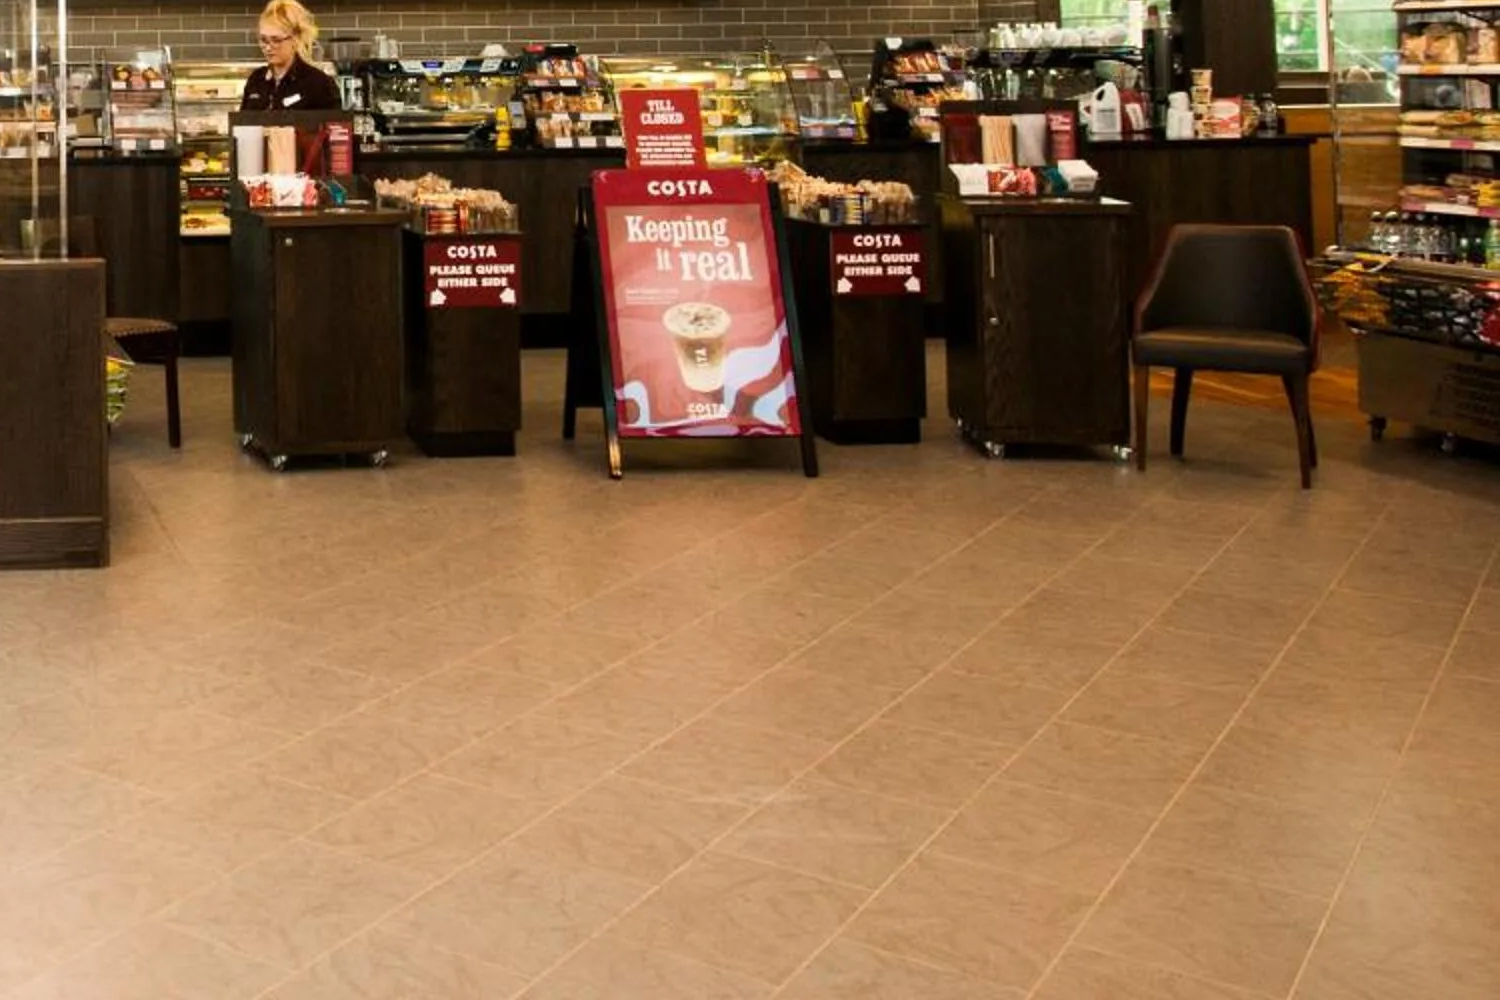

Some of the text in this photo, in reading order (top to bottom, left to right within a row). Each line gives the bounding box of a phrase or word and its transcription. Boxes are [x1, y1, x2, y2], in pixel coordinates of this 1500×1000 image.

[647, 180, 713, 197] COSTA
[625, 214, 730, 248] Keeping
[853, 233, 903, 249] COSTA
[447, 245, 497, 259] COSTA
[835, 252, 920, 264] PLEASE QUEUE
[429, 263, 515, 275] PLEASE QUEUE
[679, 241, 753, 281] real
